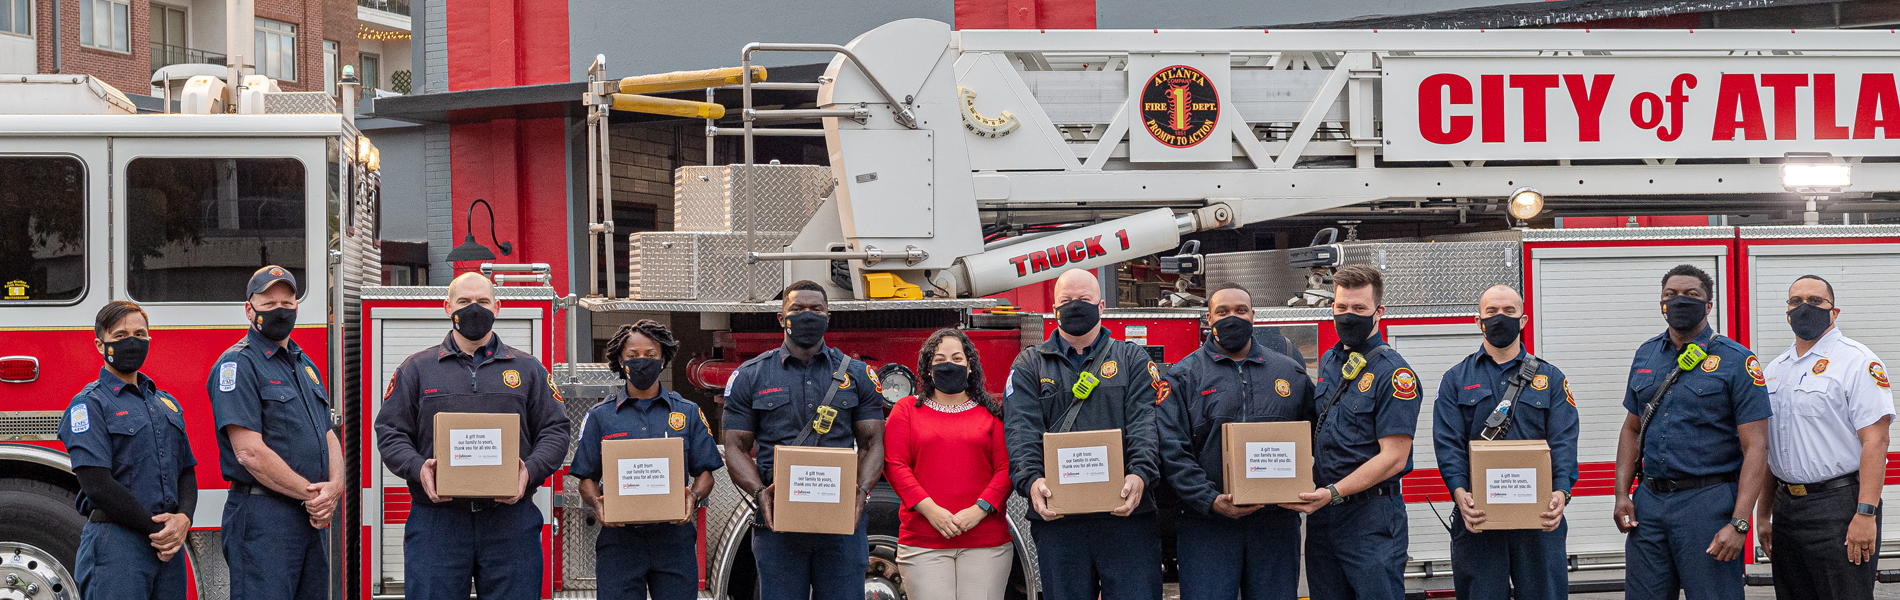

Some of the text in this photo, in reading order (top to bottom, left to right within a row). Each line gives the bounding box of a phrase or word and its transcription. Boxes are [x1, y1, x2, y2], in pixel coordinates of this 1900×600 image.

[1155, 69, 1204, 86] ATLANTA
[1145, 103, 1167, 111] FIRE
[1173, 88, 1184, 129] 1
[1418, 73, 1900, 144] CITY of ATLA
[1147, 119, 1214, 145] PROMPT TO ACTION
[1009, 229, 1130, 277] TRUCK 1
[14, 287, 19, 295] 4
